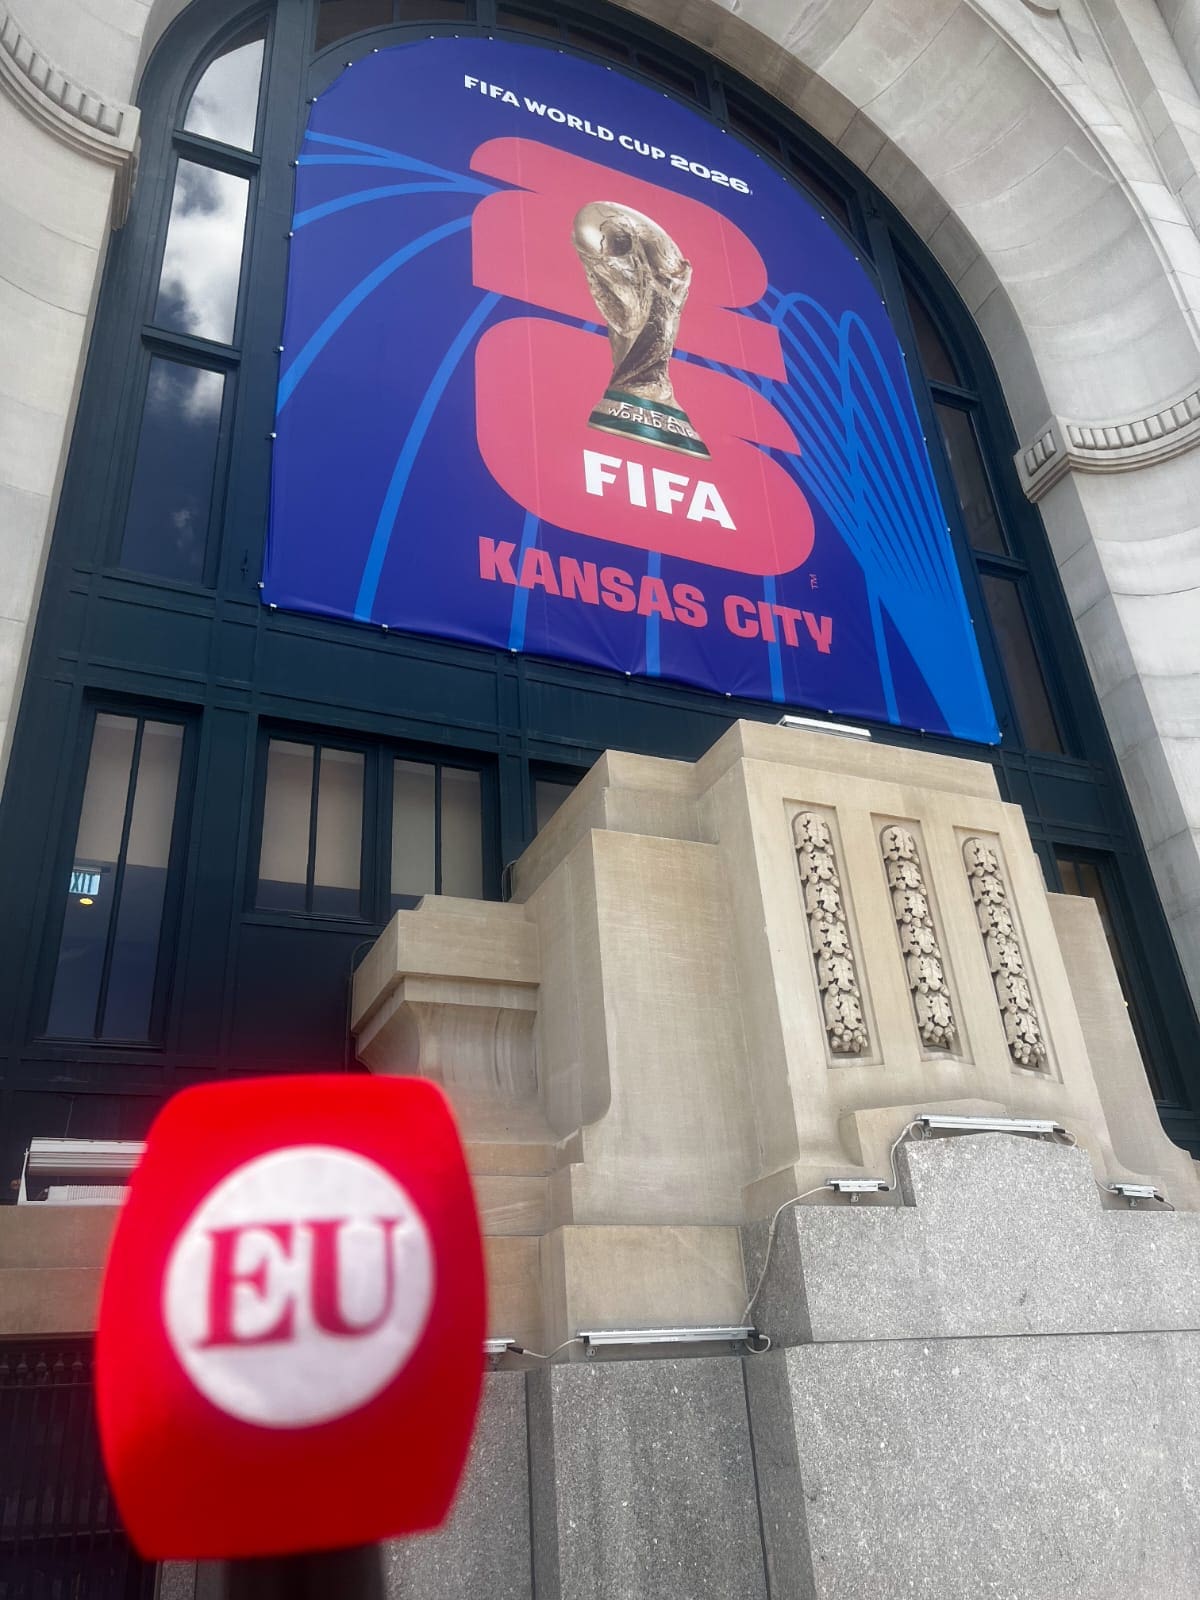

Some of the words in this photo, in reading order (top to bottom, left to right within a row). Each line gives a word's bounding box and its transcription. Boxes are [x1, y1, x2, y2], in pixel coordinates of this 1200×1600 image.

[464, 74, 520, 108] FIFA
[523, 97, 615, 142] WORLD
[618, 135, 666, 160] CUP
[669, 154, 750, 194] 2026
[608, 407, 662, 428] WORLD
[583, 449, 737, 531] FIFA
[478, 536, 708, 628] KANSAS
[723, 595, 833, 655] CITY
[71, 871, 97, 893] XIT
[195, 1216, 403, 1350] EU
